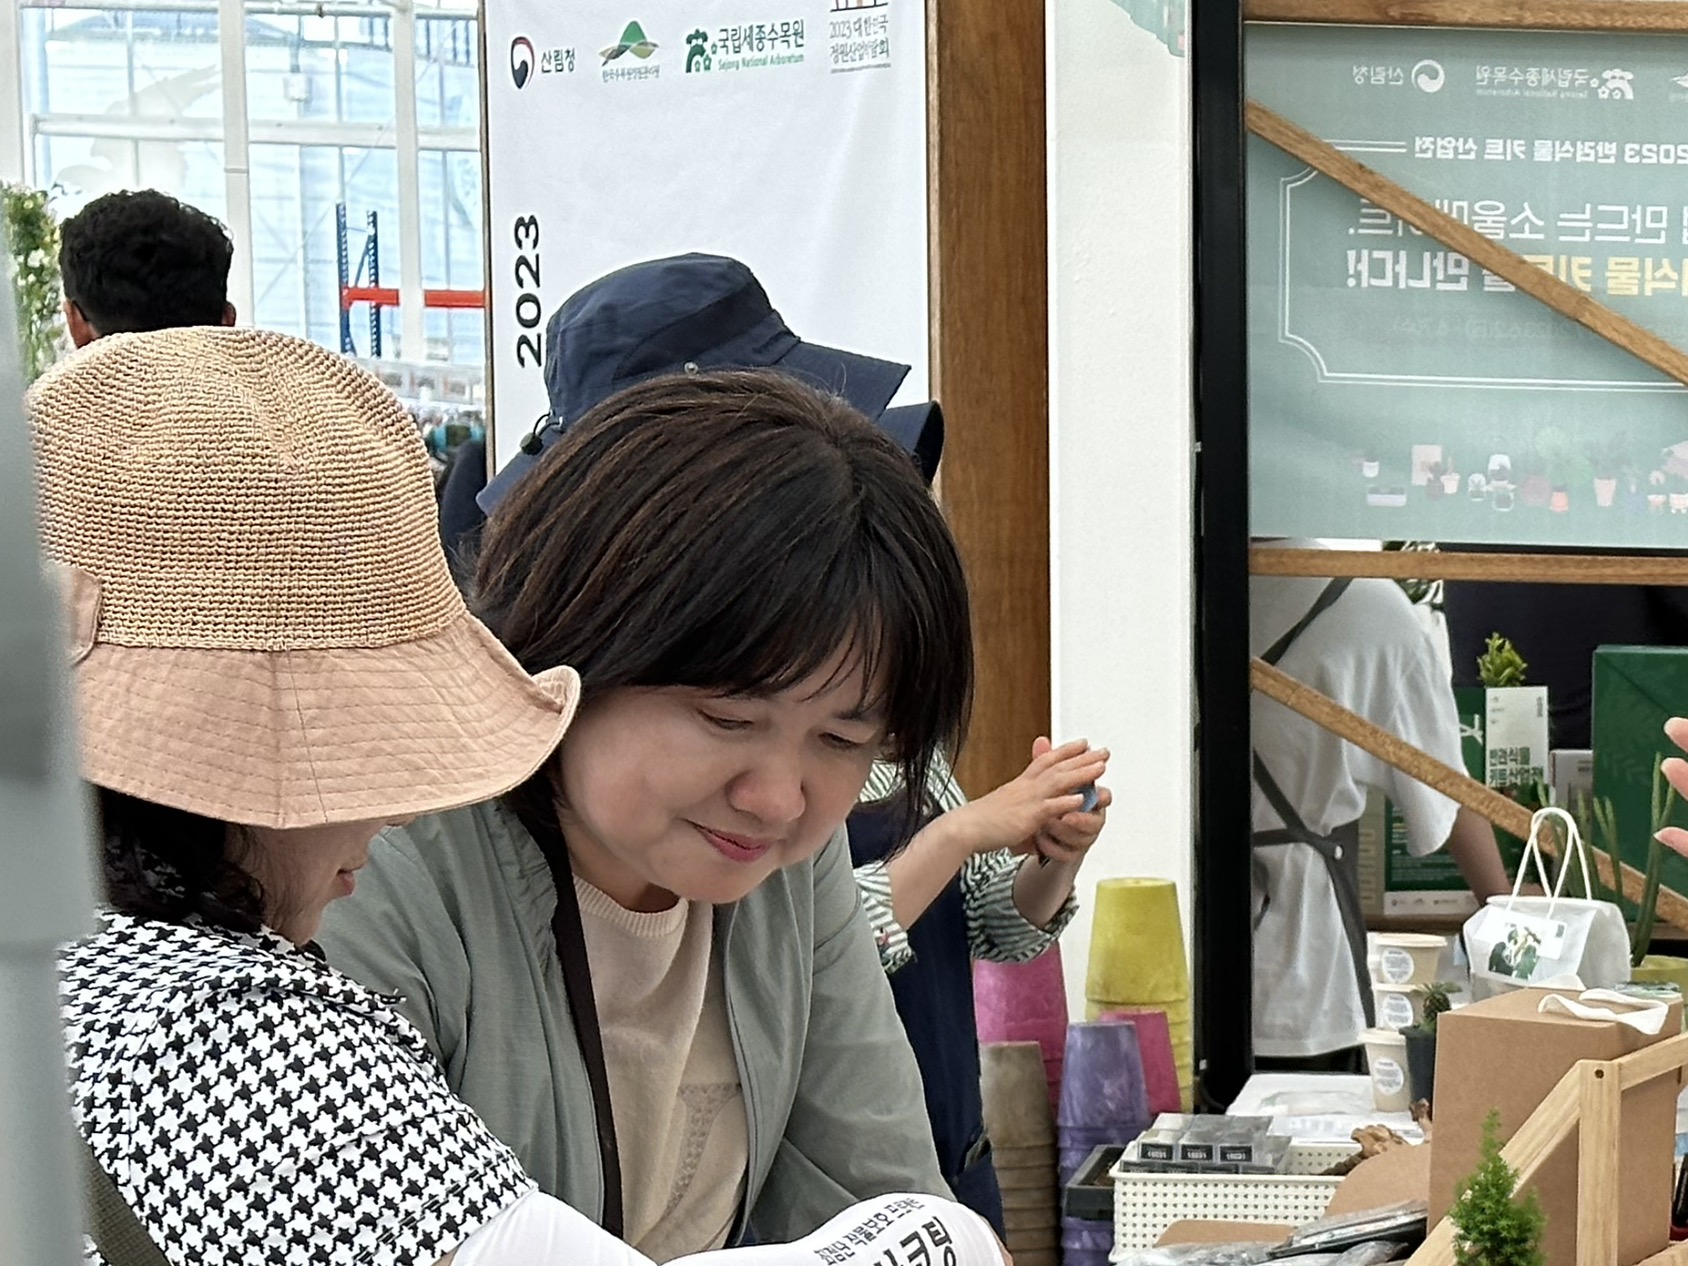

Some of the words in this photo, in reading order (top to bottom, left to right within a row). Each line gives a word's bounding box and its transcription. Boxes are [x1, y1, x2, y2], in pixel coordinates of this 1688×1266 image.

[718, 18, 804, 56] 국립세종수목원
[540, 47, 576, 74] 산림청
[514, 214, 542, 369] 2023
